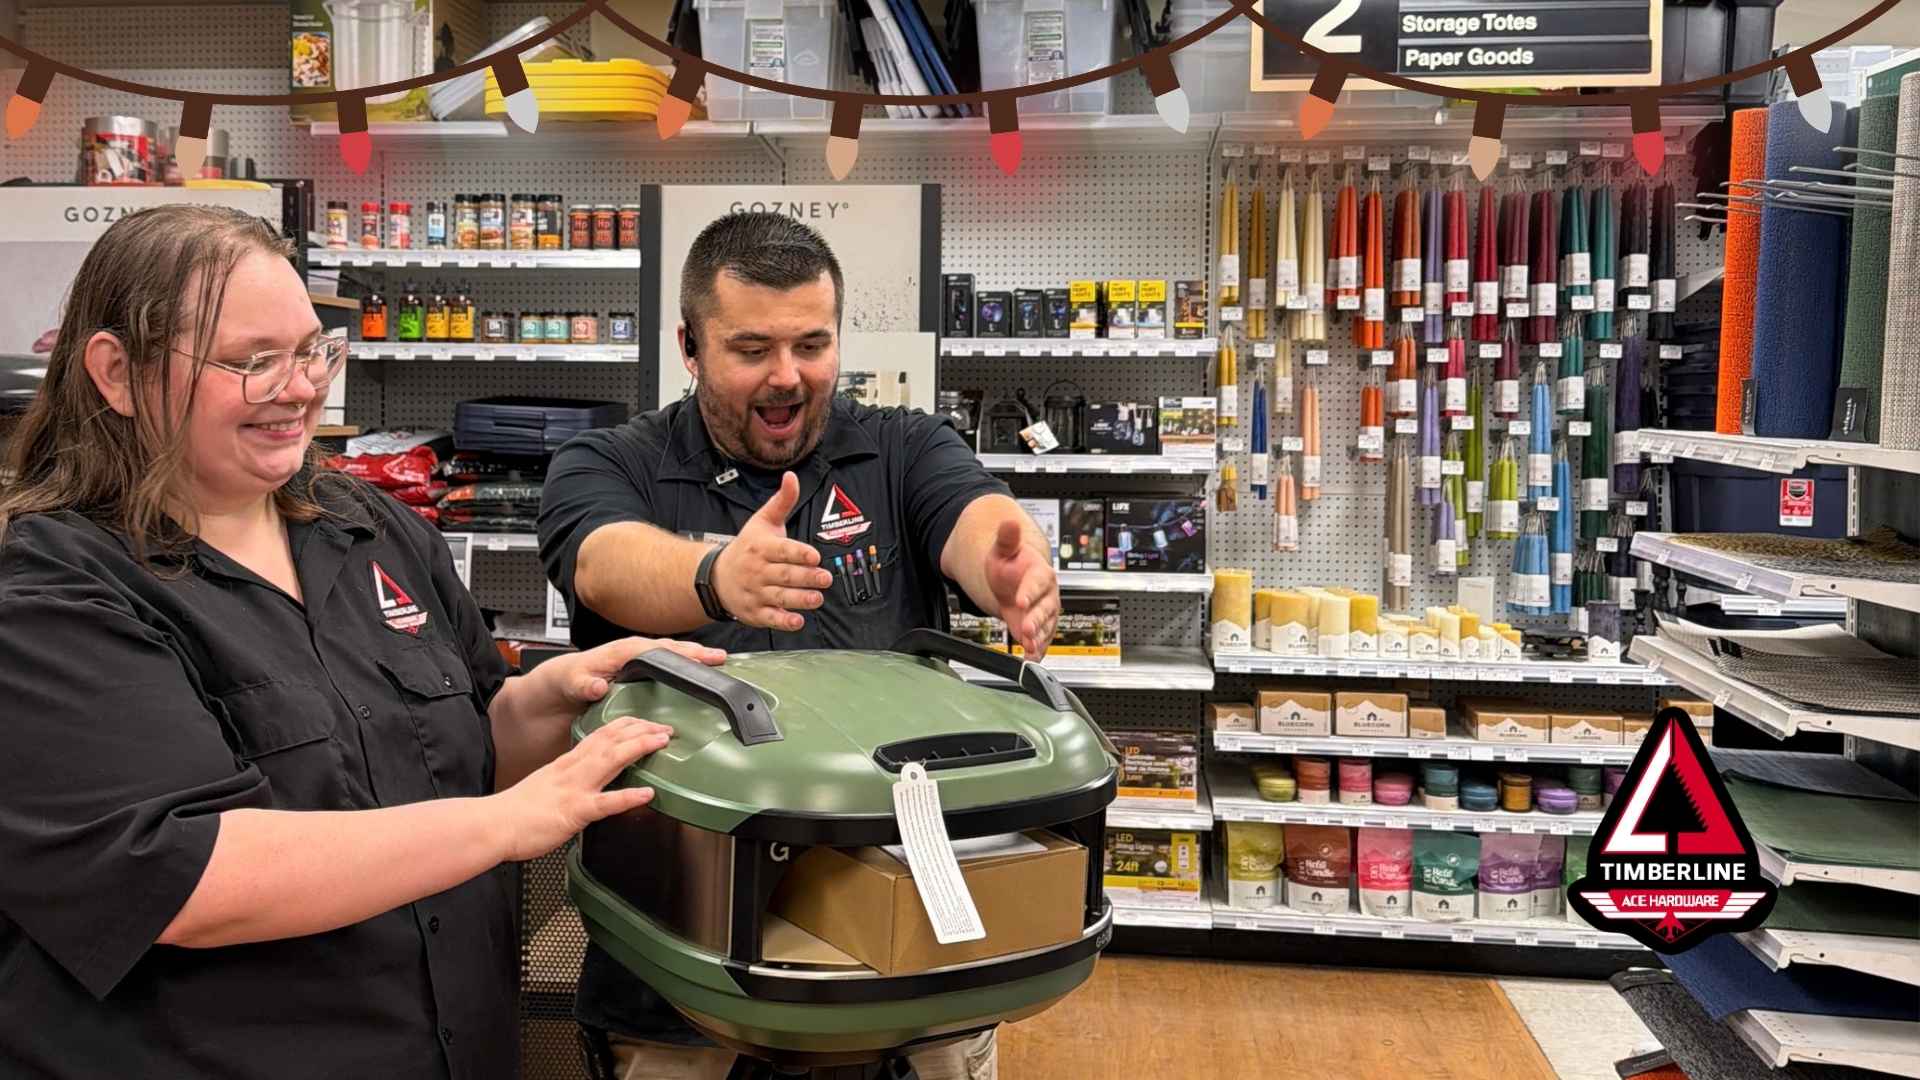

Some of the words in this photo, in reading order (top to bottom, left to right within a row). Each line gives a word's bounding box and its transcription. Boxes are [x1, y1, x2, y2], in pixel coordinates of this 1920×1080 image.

[1301, 0, 1363, 53] 2
[1402, 14, 1480, 34] Storage
[1484, 14, 1538, 32] Totes
[1405, 49, 1463, 69] Paper
[1467, 48, 1534, 66] Goods
[1112, 503, 1130, 512] LIFX
[1116, 833, 1134, 843] LED
[1115, 858, 1140, 872] 24ft
